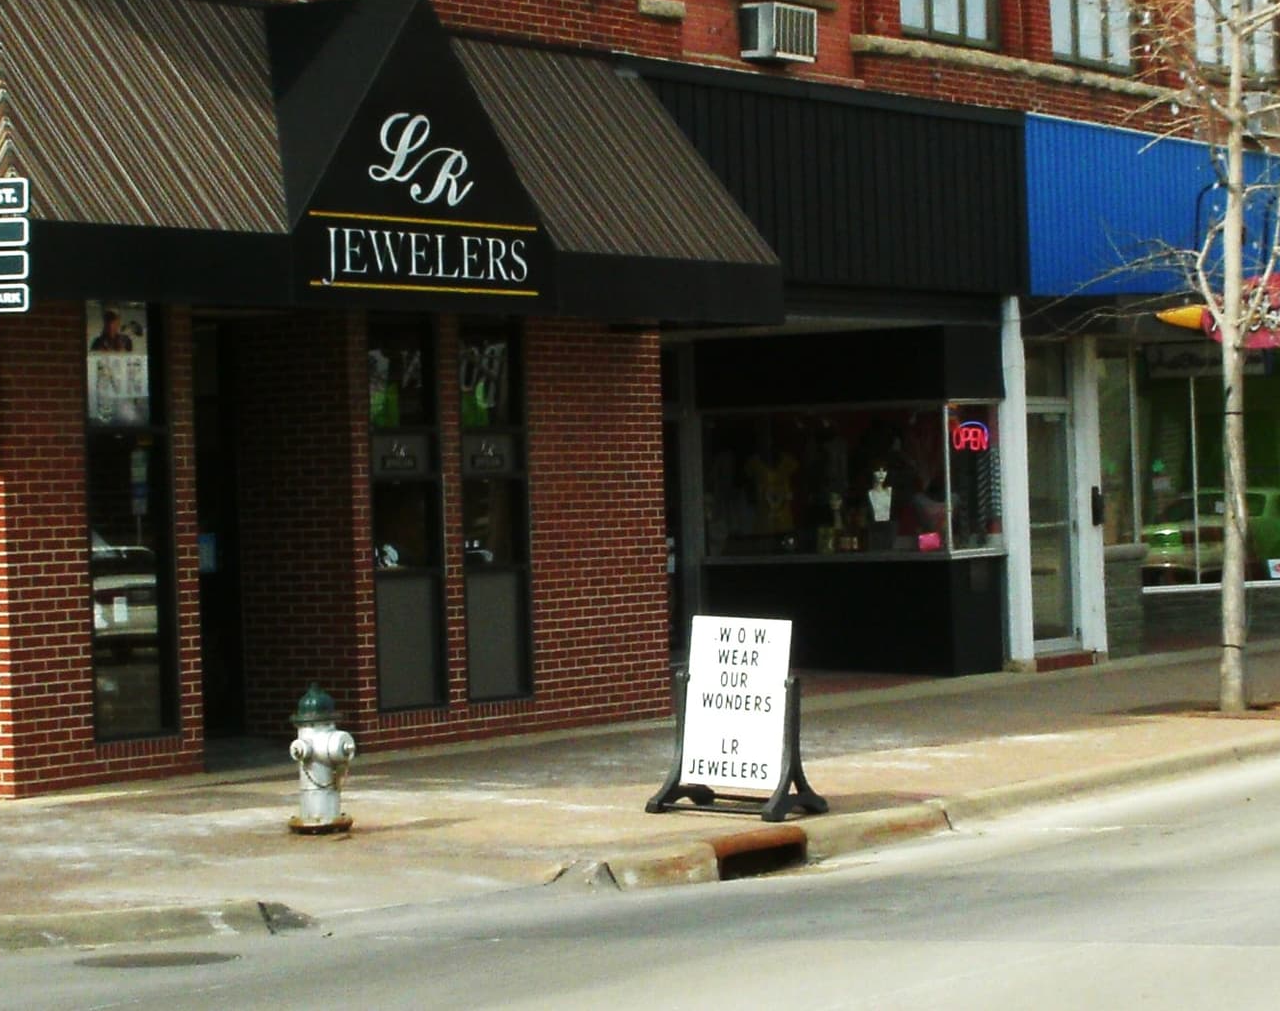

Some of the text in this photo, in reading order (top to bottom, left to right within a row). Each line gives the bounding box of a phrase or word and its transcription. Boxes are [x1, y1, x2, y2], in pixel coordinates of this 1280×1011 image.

[322, 227, 528, 285] JEWELERS
[953, 427, 989, 451] OPEN
[718, 649, 759, 667] WEAR
[720, 671, 748, 688] OUR
[702, 692, 772, 713] WONDERS
[688, 759, 768, 780] JEWELERS
